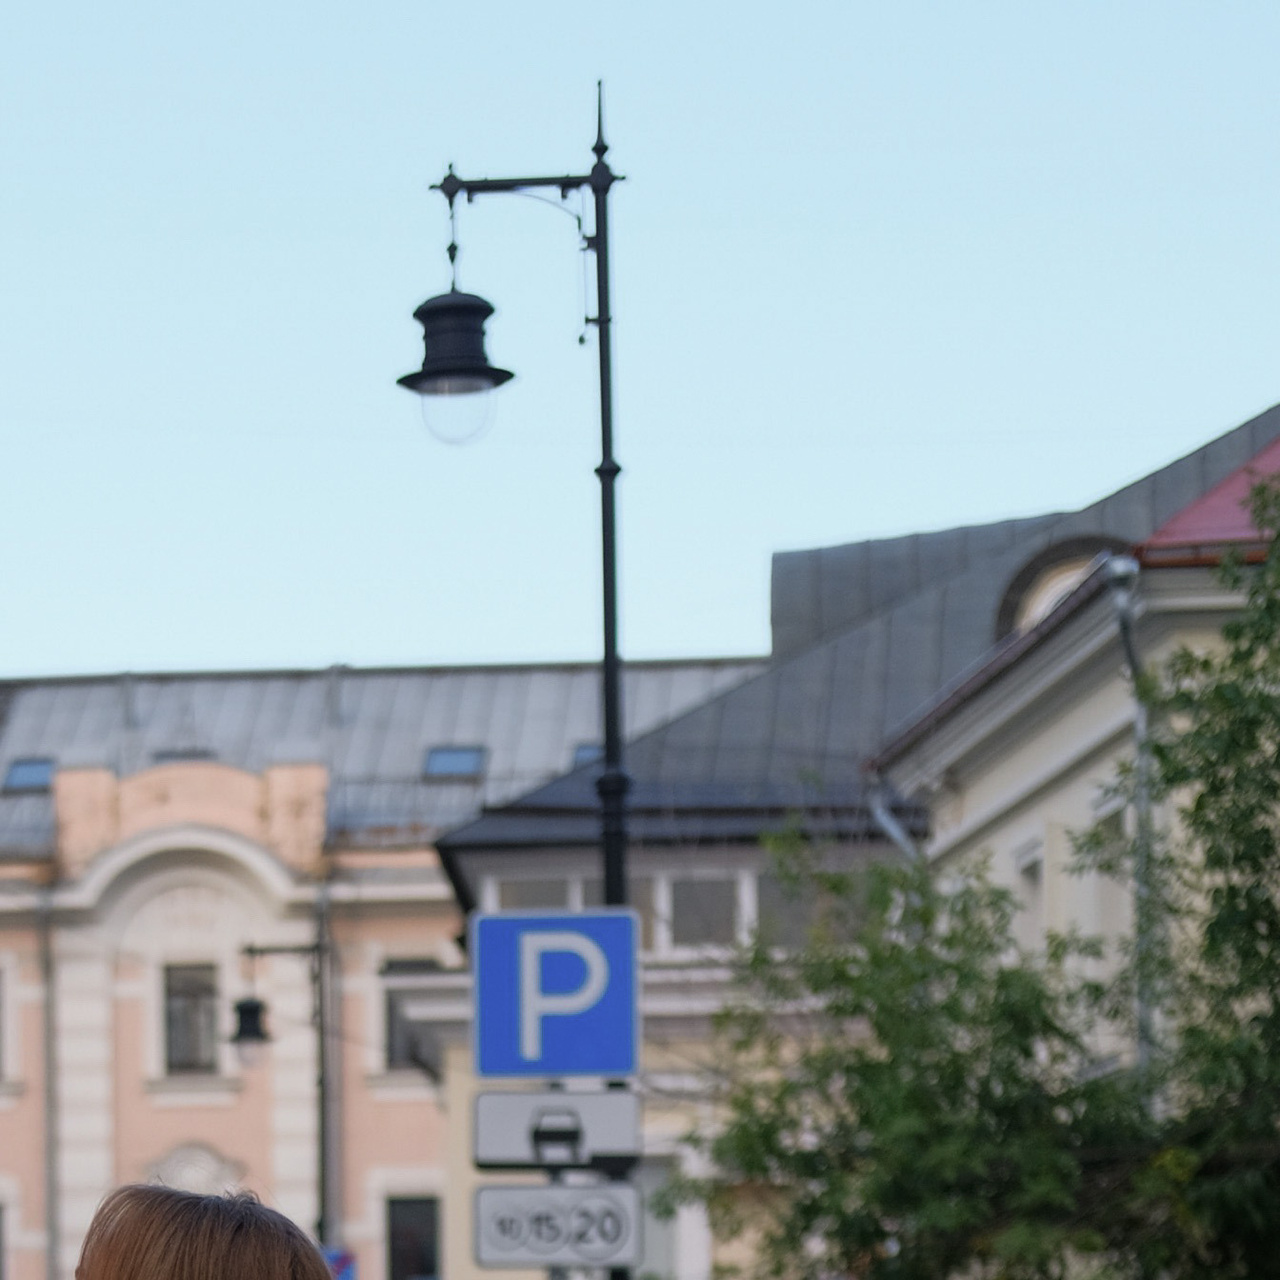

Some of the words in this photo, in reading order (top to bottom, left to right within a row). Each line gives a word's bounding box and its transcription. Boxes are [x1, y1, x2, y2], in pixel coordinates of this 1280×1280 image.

[519, 931, 610, 1061] P
[531, 1213, 562, 1244] 15
[573, 1209, 622, 1245] 20
